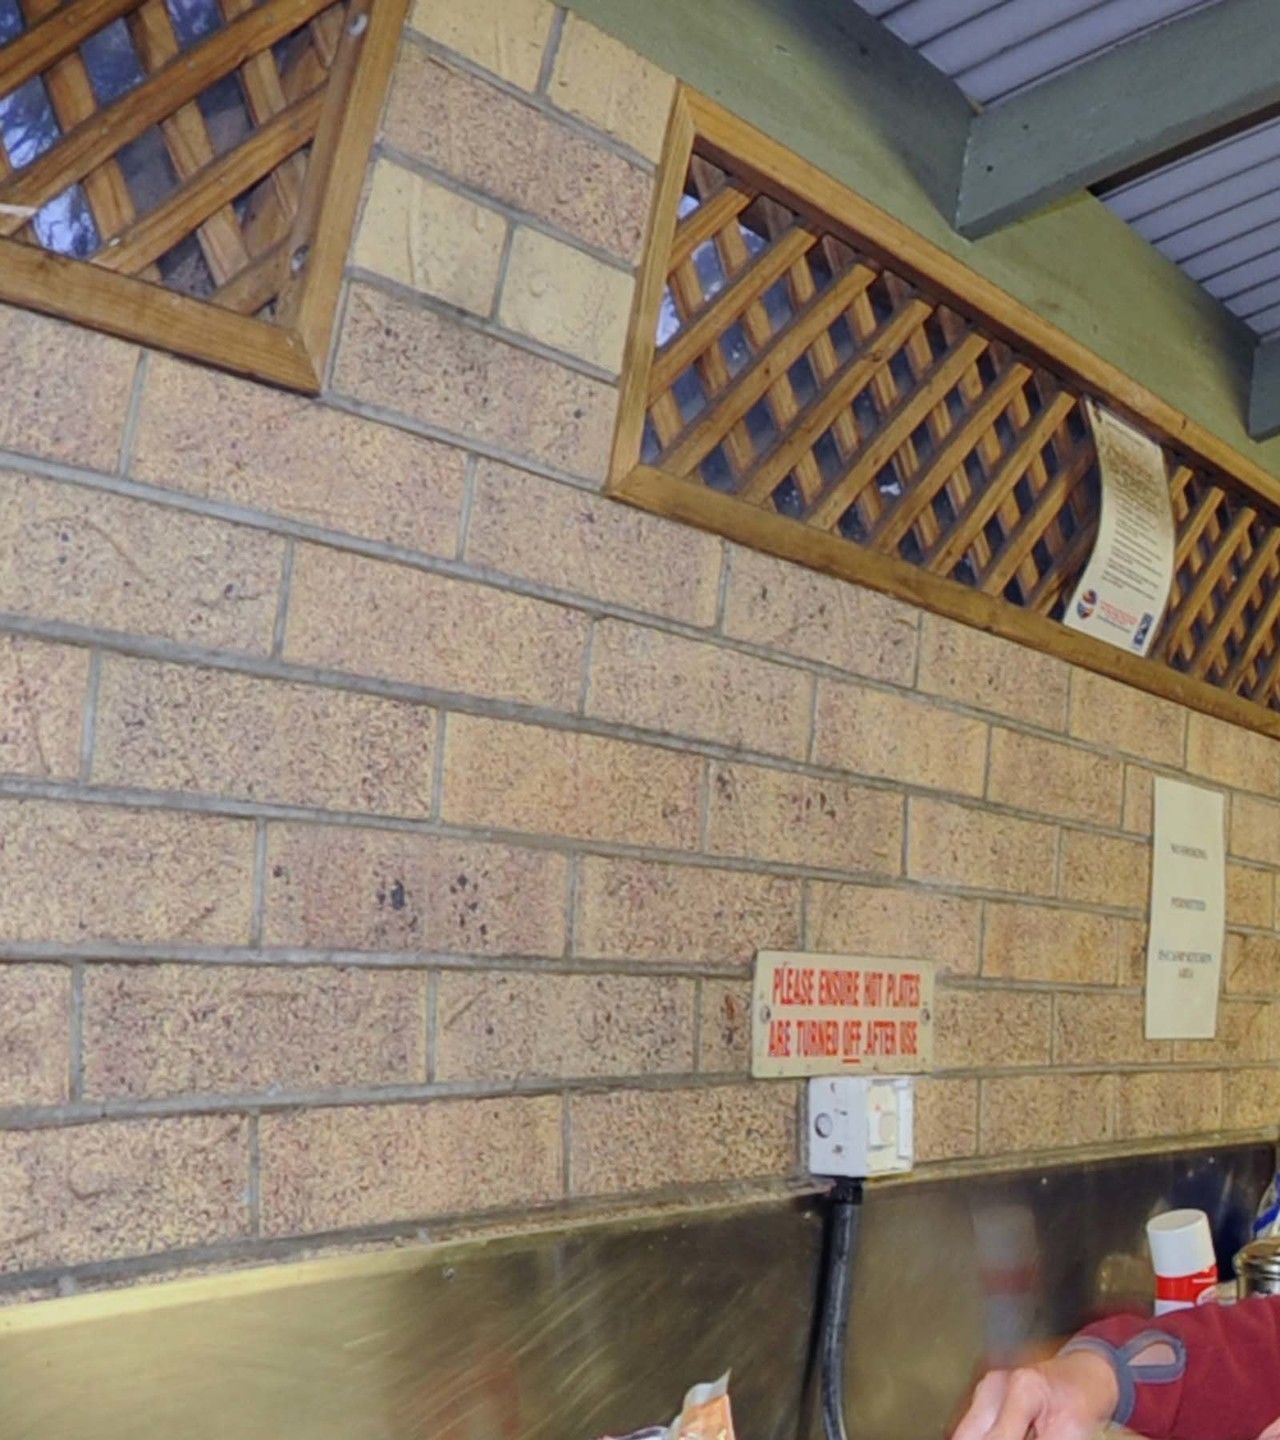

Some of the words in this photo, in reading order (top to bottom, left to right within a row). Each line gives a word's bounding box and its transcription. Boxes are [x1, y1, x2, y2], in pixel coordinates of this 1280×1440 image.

[773, 967, 815, 1005] PLEASE
[818, 968, 860, 1007] ENSURE
[863, 970, 884, 1008] HOT
[886, 972, 921, 1009] PLATES
[768, 1018, 791, 1058] ARE
[796, 1018, 840, 1057] TURNED
[842, 1018, 863, 1057] OFF
[864, 1019, 897, 1057] AFTER
[900, 1019, 919, 1056] USE
